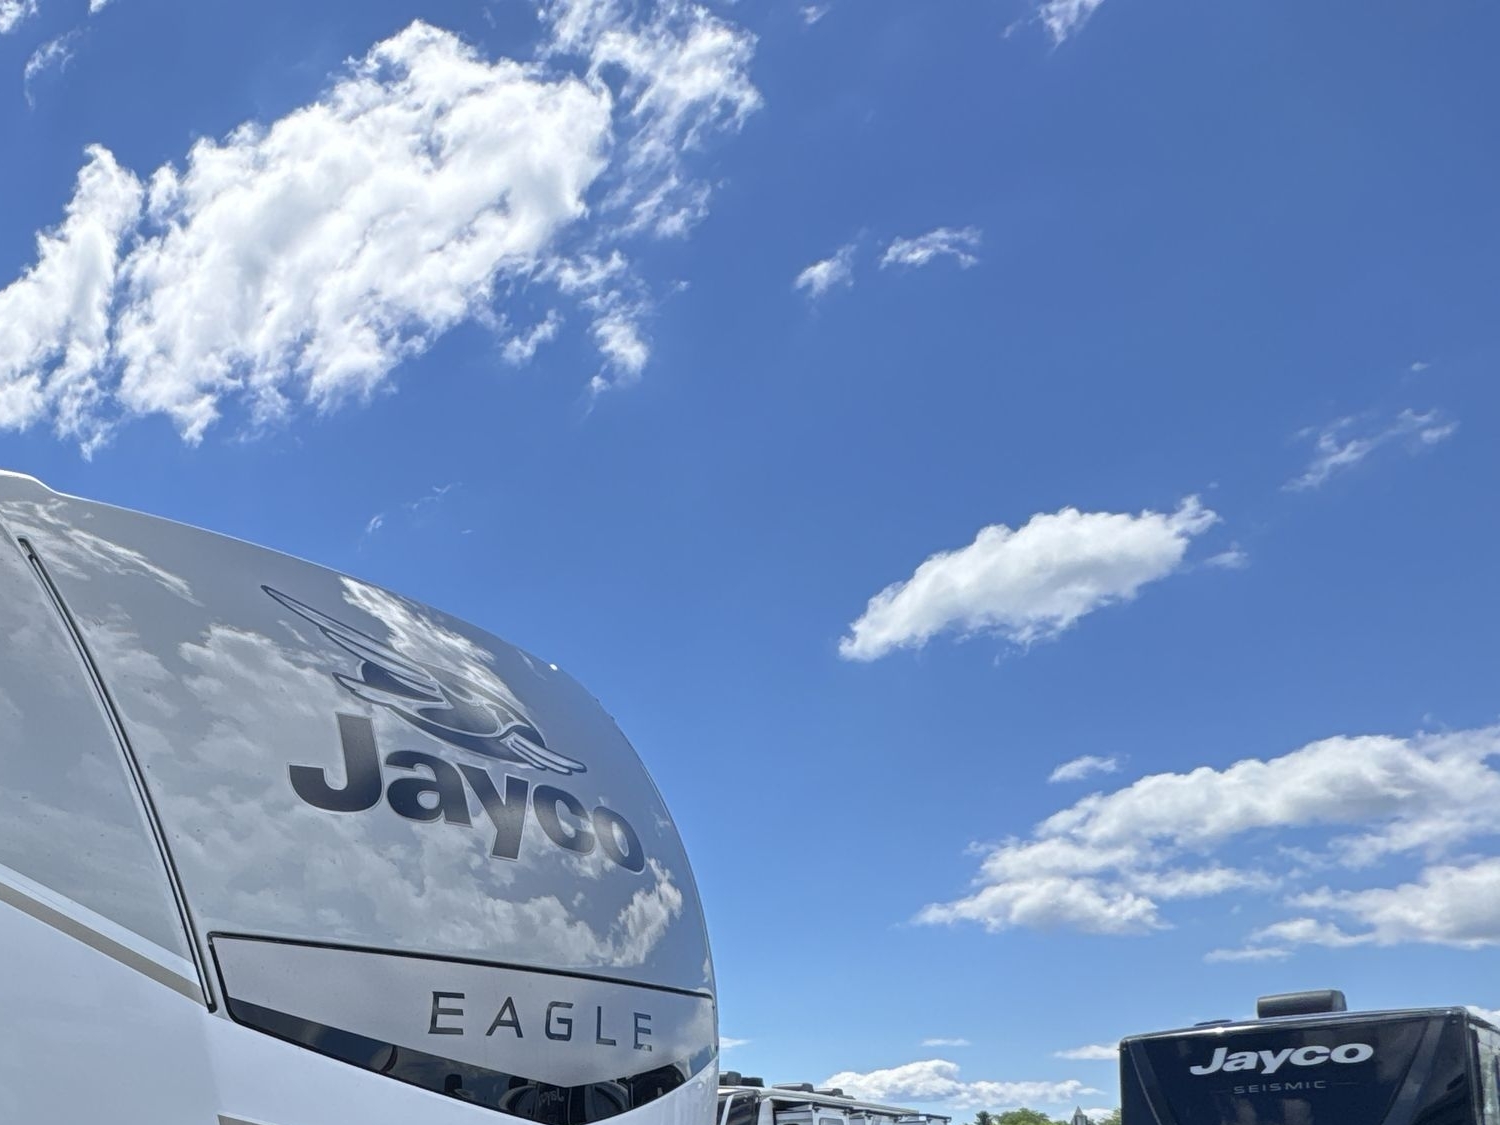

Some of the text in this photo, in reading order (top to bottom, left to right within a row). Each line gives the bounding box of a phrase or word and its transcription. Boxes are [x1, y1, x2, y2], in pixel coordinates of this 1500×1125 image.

[288, 711, 645, 874] Jayco
[428, 990, 653, 1052] EAGLE
[1189, 1042, 1375, 1076] Jayco
[1233, 1080, 1327, 1095] SEISMIC
